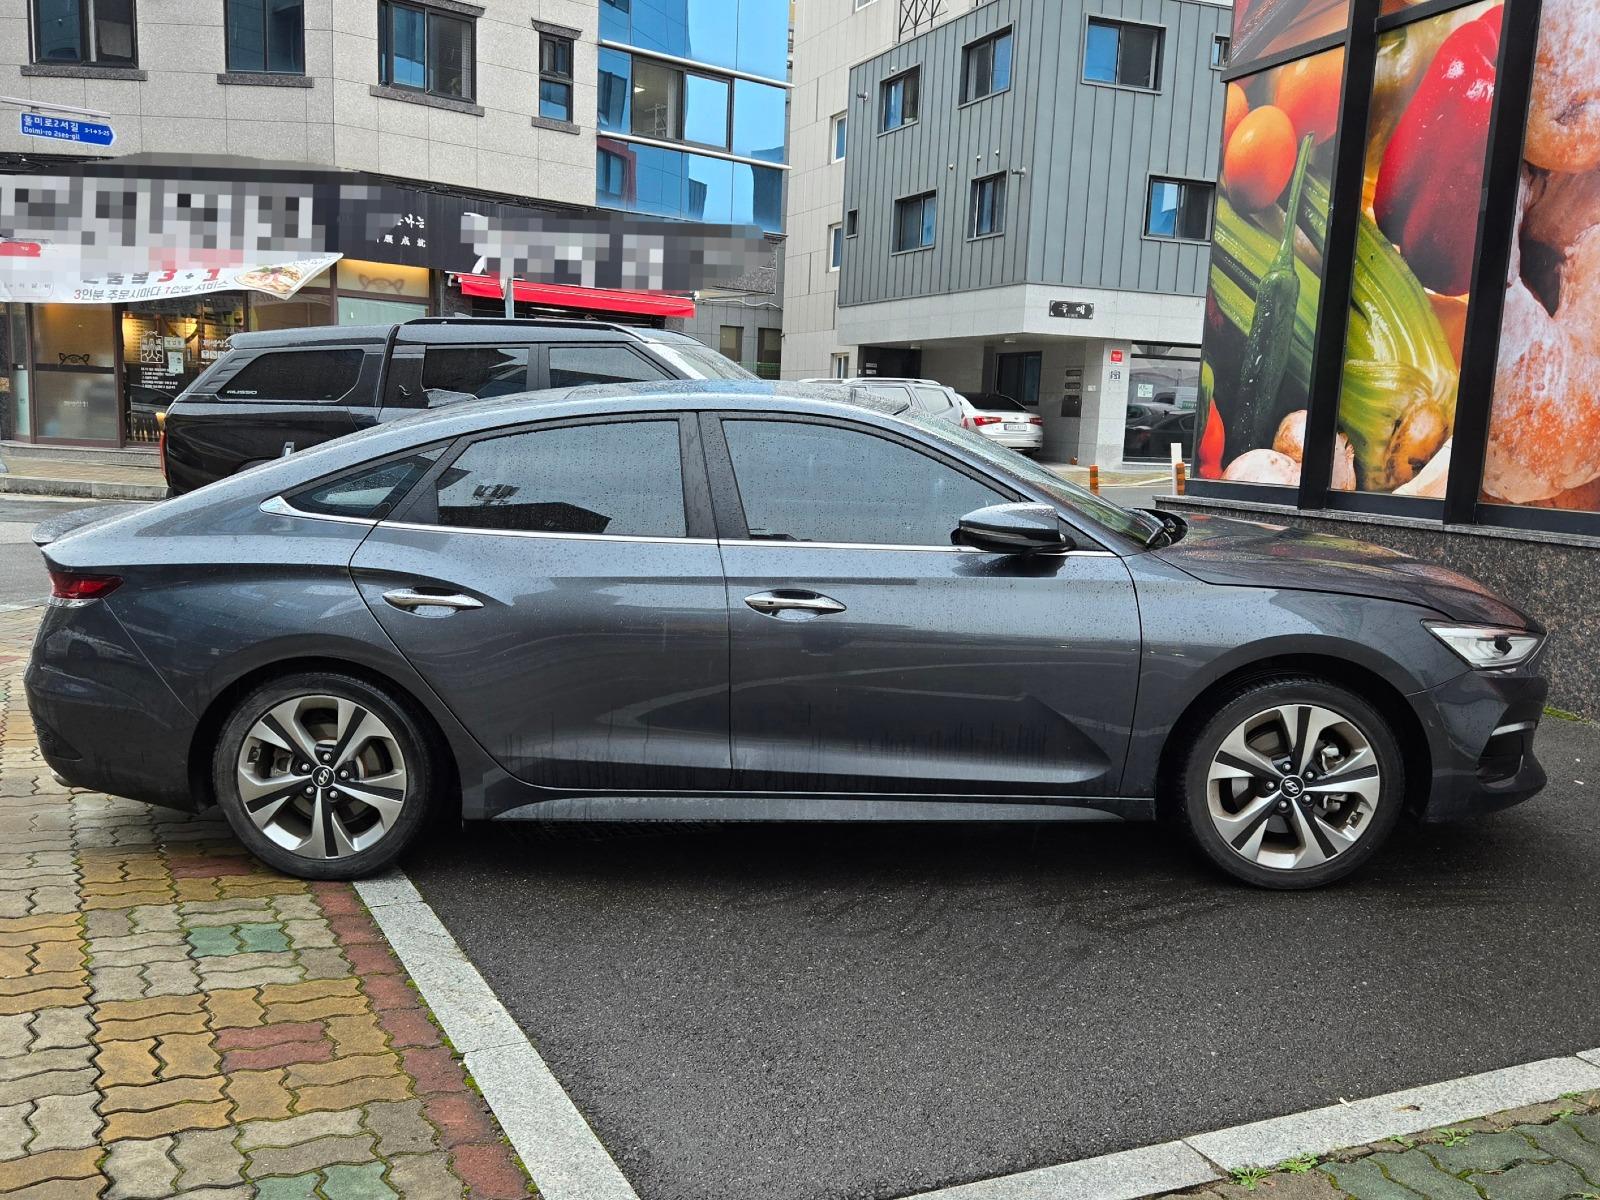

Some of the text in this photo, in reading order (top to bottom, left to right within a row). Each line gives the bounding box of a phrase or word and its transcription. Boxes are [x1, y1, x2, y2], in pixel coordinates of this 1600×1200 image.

[74, 288, 104, 301] 3인분
[107, 285, 161, 300] 주문시마다
[194, 280, 229, 291] 서비스
